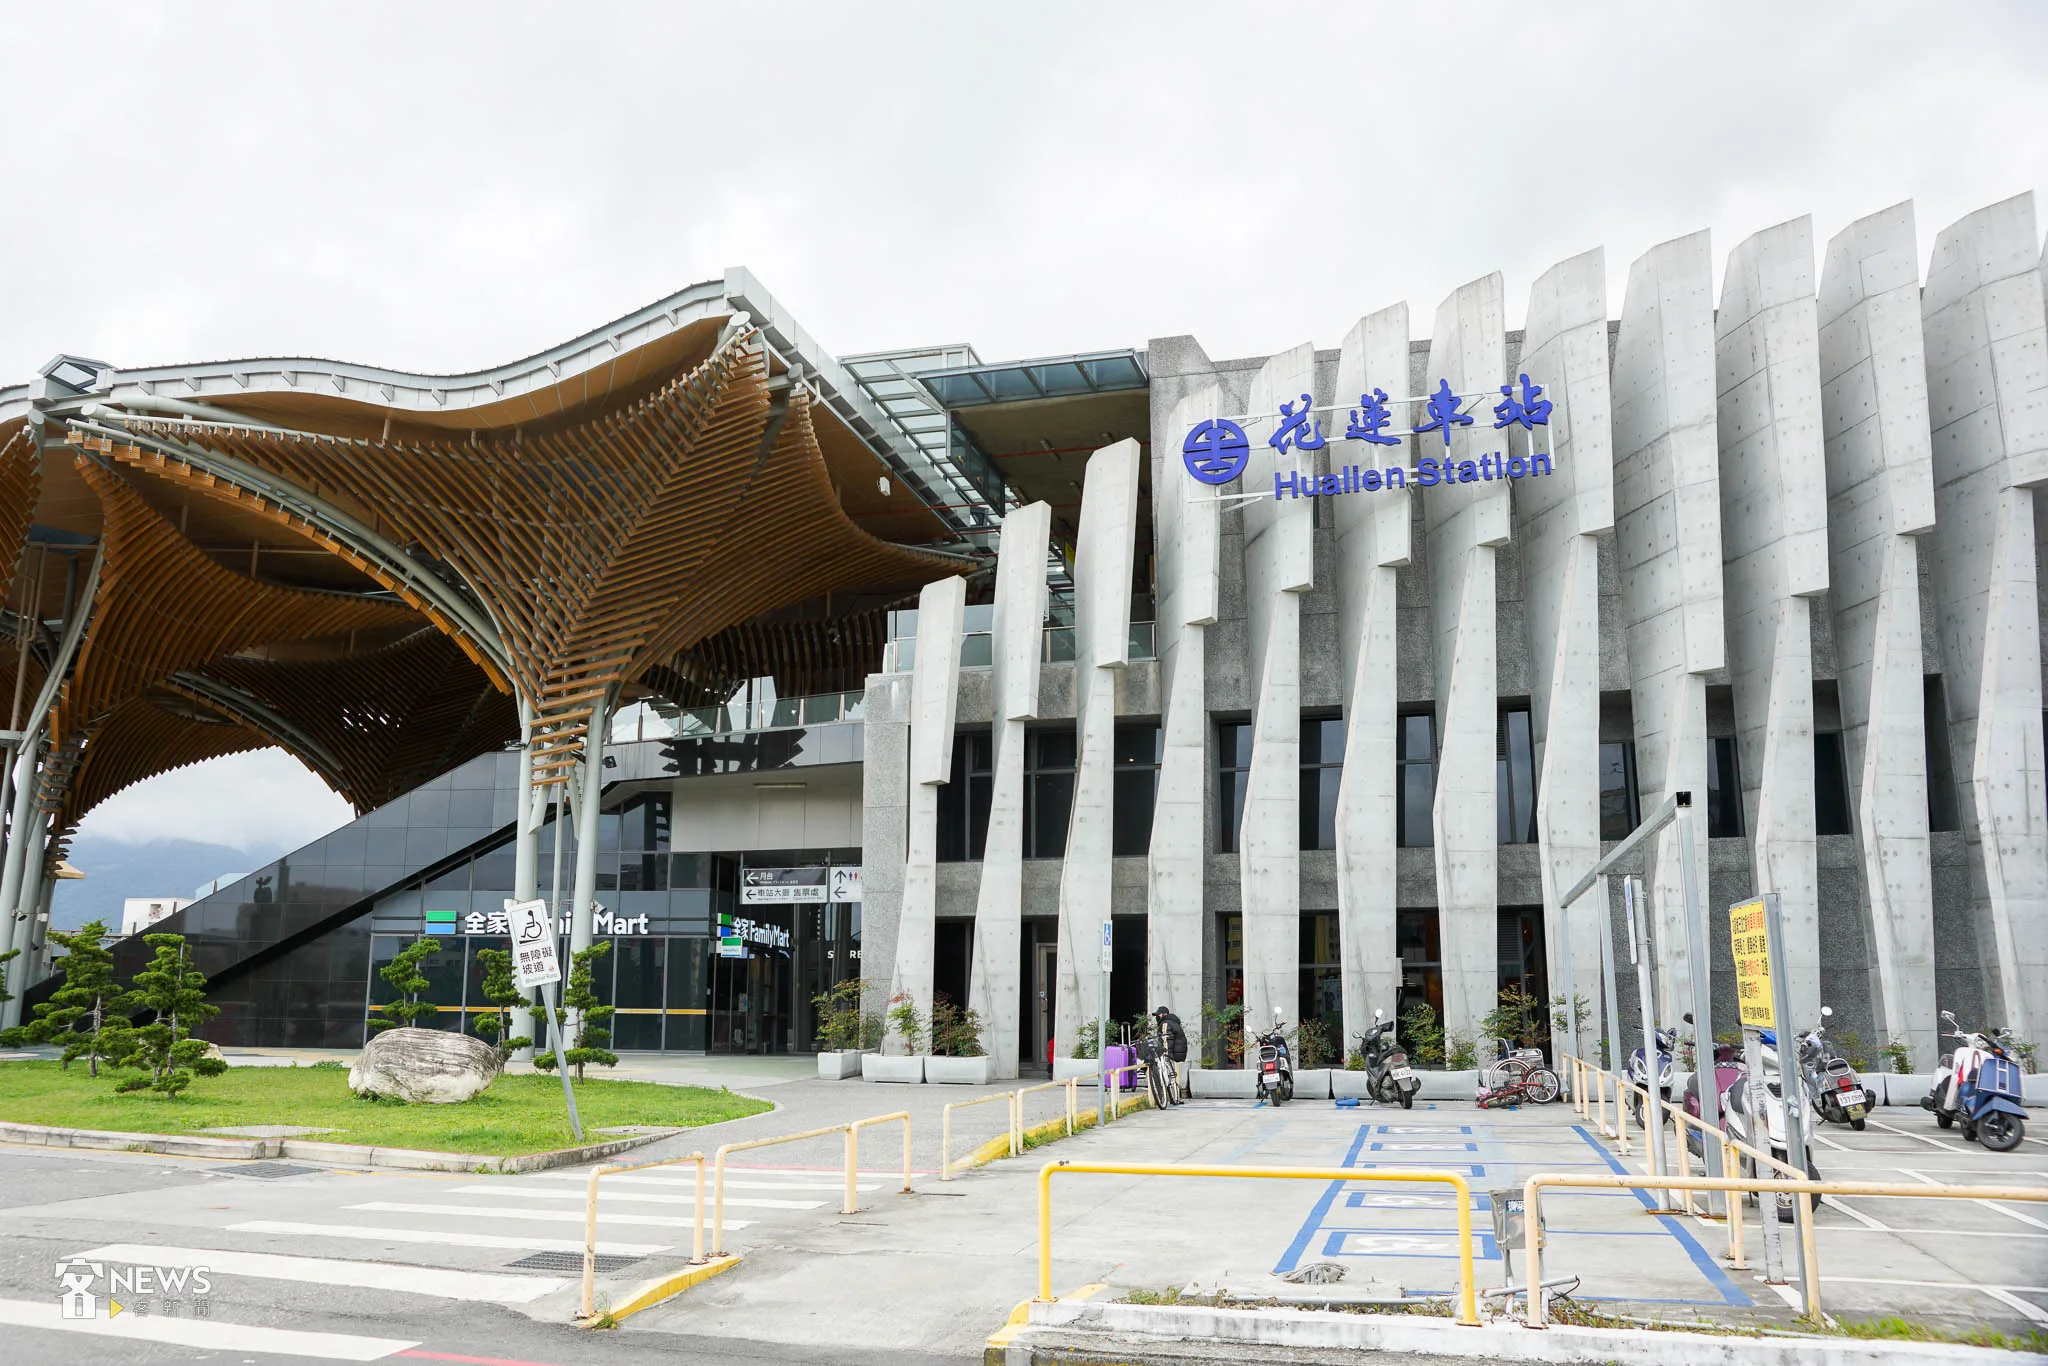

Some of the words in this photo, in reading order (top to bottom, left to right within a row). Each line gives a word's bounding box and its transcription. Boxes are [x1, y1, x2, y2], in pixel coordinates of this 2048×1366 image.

[1269, 373, 1553, 456] 花蓮車站
[1275, 465, 1405, 500] Hualien
[1416, 452, 1552, 487] Station
[760, 872, 774, 881] 月台
[465, 911, 508, 934] 全家
[733, 917, 749, 941] 全家
[750, 920, 789, 948] FamilyMart
[520, 946, 553, 963] 無障礙
[522, 961, 545, 975] 坡道
